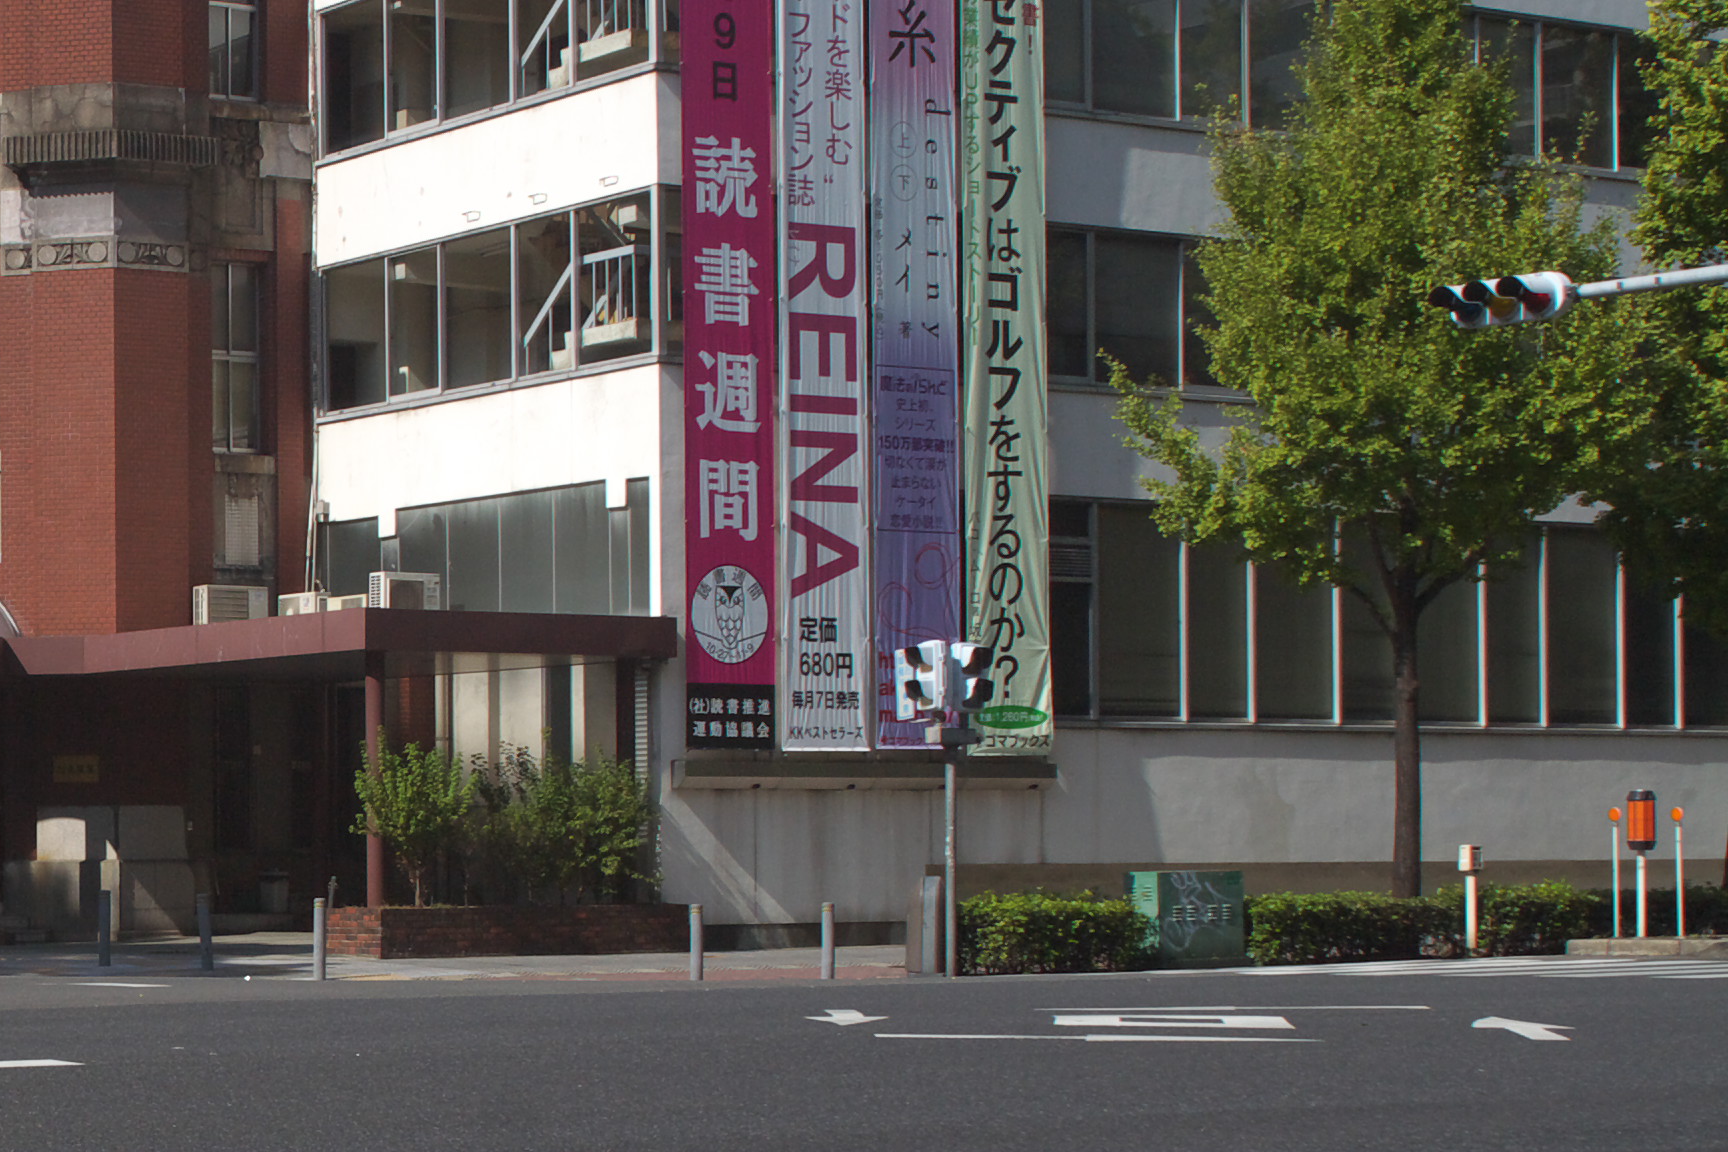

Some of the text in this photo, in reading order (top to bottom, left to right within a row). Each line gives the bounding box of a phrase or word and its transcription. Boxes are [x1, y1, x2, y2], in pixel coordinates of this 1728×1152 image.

[922, 98, 952, 340] destiny
[691, 134, 761, 541] 読書週間
[787, 221, 860, 600] REINA
[894, 416, 937, 432] シリーズ
[890, 476, 942, 491] 止まらない
[895, 495, 937, 509] ケータイ
[799, 616, 838, 643] 定価
[799, 651, 854, 679] 680円
[792, 690, 860, 710] 毎月7日発売
[692, 720, 771, 739] 運動協議会
[789, 726, 864, 740] KKベストセラーズ
